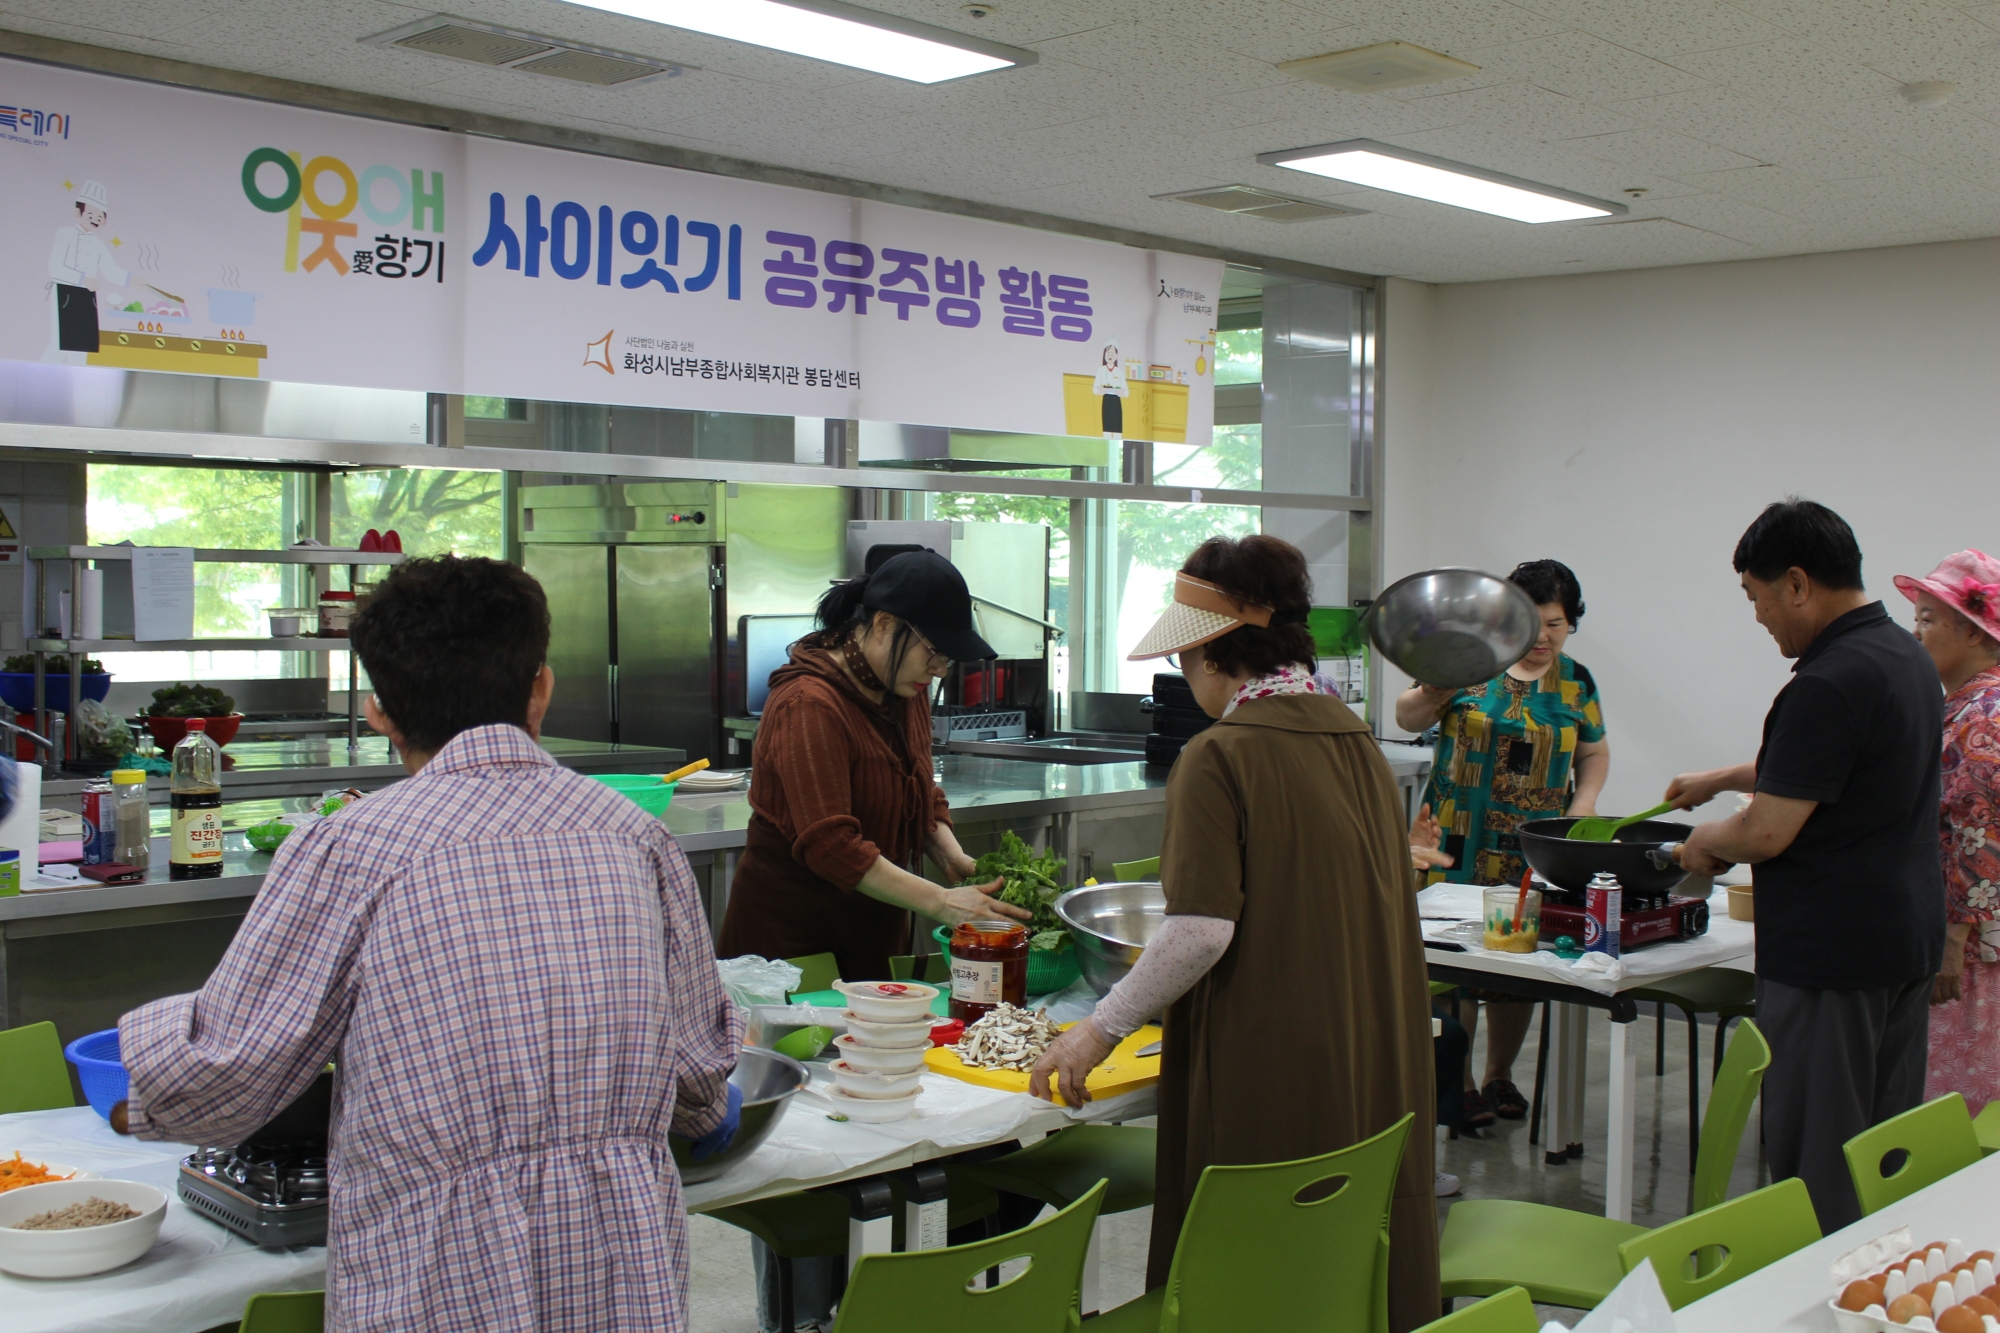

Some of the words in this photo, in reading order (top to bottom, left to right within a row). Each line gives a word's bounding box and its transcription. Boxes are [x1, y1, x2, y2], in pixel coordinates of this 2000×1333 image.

[472, 191, 743, 301] 사이잇기
[763, 230, 985, 328] 공유주방
[998, 266, 1093, 342] 활동
[625, 336, 655, 349] 사단법인
[656, 339, 679, 351] 나눔과
[679, 341, 695, 353] 실천
[623, 352, 800, 385] 화성시남부종합사회복지관
[804, 366, 862, 390] 봉담센터
